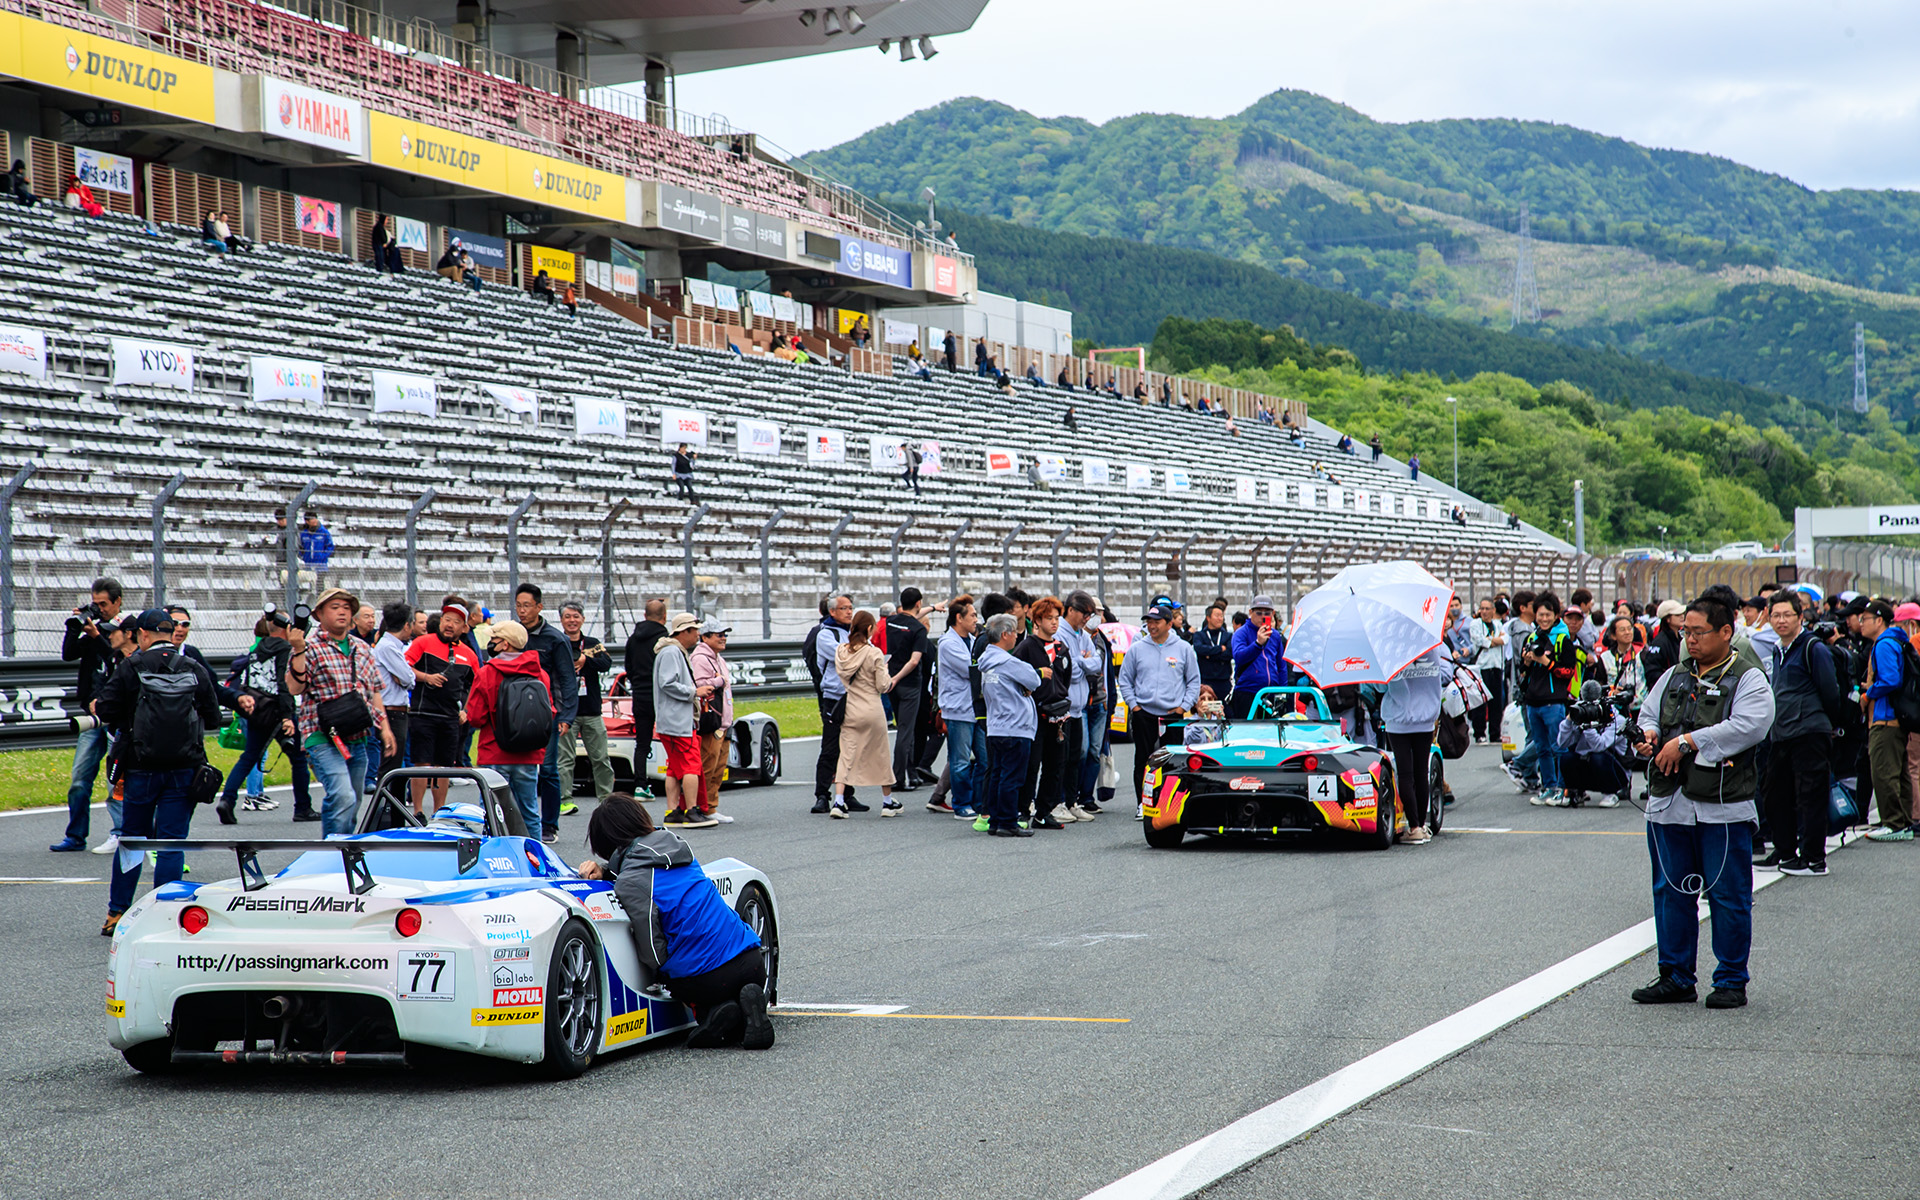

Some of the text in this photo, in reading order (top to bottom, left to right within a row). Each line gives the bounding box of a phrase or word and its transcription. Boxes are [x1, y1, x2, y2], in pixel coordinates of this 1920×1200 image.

[84, 51, 178, 95] DUNLOP
[294, 96, 351, 142] YAMAHA
[414, 138, 481, 172] DUNLOP
[545, 171, 602, 202] DUNLOP
[542, 257, 572, 271] DUNLOP
[863, 250, 899, 276] SUBARU
[1317, 779, 1330, 797] 4
[1354, 798, 1376, 808] MOTUL
[177, 954, 389, 972] http://passingmark.com
[408, 959, 446, 993] 77
[496, 973, 534, 985] bio labo
[495, 989, 542, 1005] MOTUL
[487, 1011, 540, 1022] DUNLOP
[614, 1018, 645, 1036] DUNLOP
